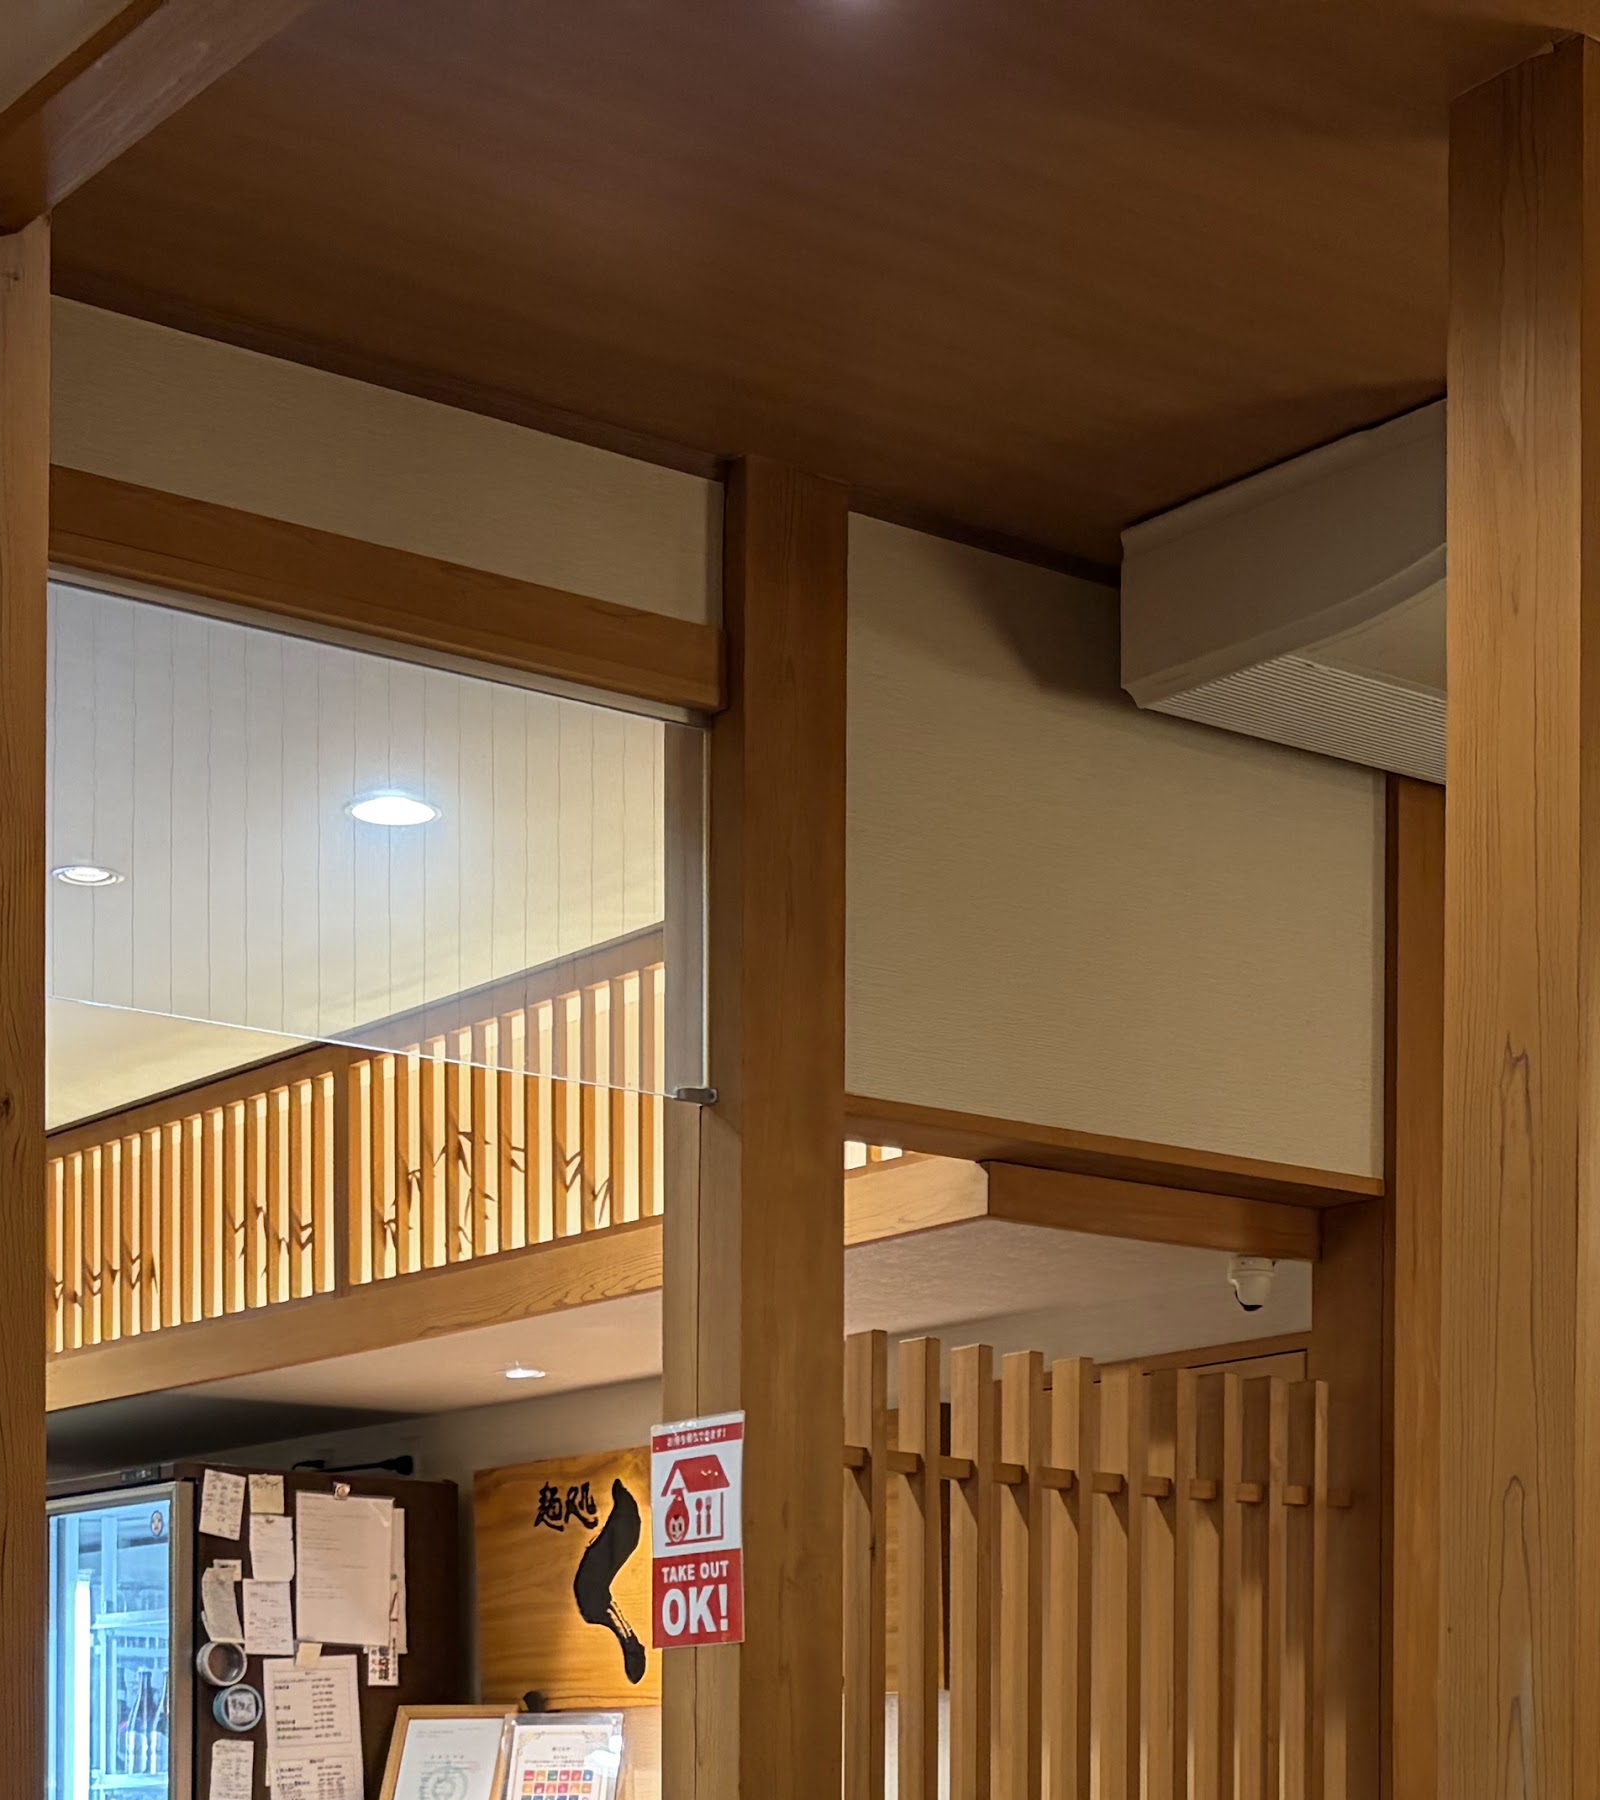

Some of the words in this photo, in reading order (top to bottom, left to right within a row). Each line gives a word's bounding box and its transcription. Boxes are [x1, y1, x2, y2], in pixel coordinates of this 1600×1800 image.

[534, 1481, 599, 1532] 麺処
[661, 1564, 696, 1583] TAKE
[700, 1560, 729, 1579] OUT
[662, 1583, 729, 1637] OK!
